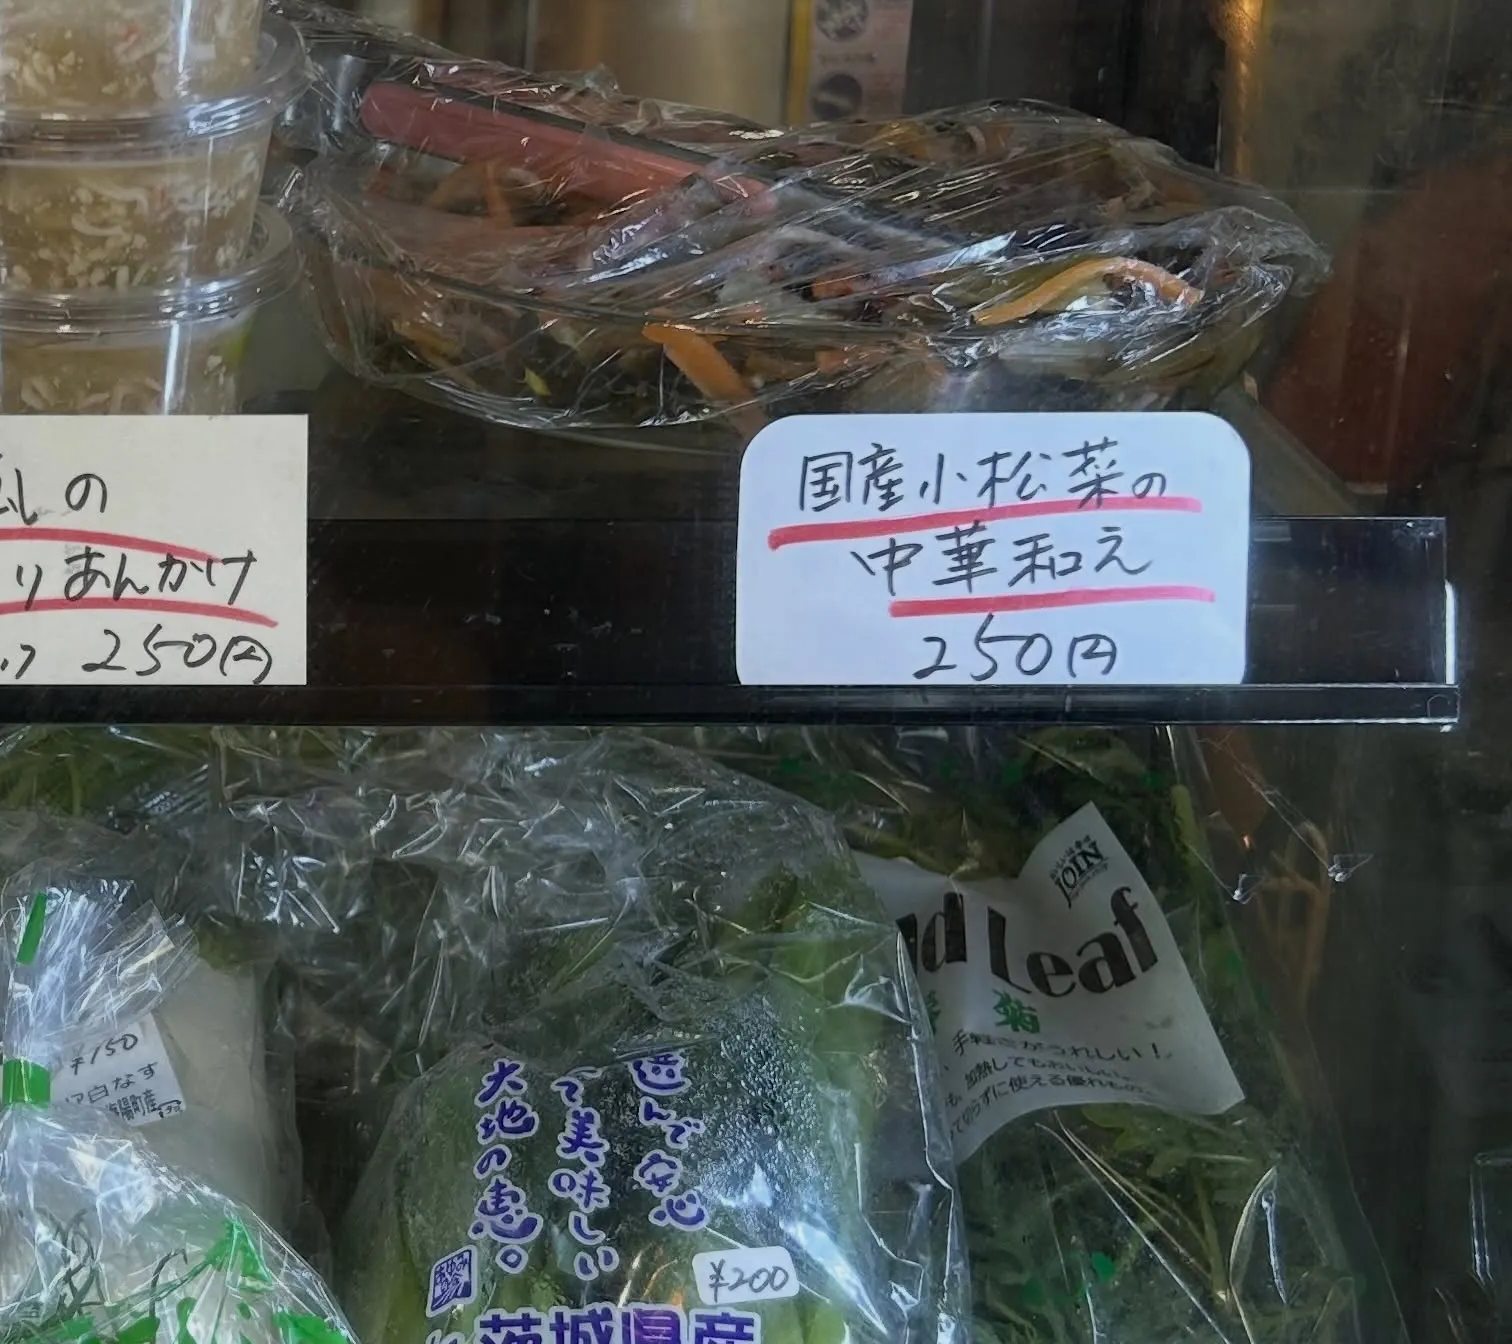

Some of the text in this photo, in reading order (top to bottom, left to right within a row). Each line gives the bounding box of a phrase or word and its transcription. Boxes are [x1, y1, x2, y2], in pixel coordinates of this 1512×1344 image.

[800, 437, 1167, 512] 国産小松菜の
[851, 520, 1152, 595] 中華和え
[82, 623, 272, 684] 250円
[913, 613, 1118, 682] 250円
[709, 1260, 788, 1305] ¥200
